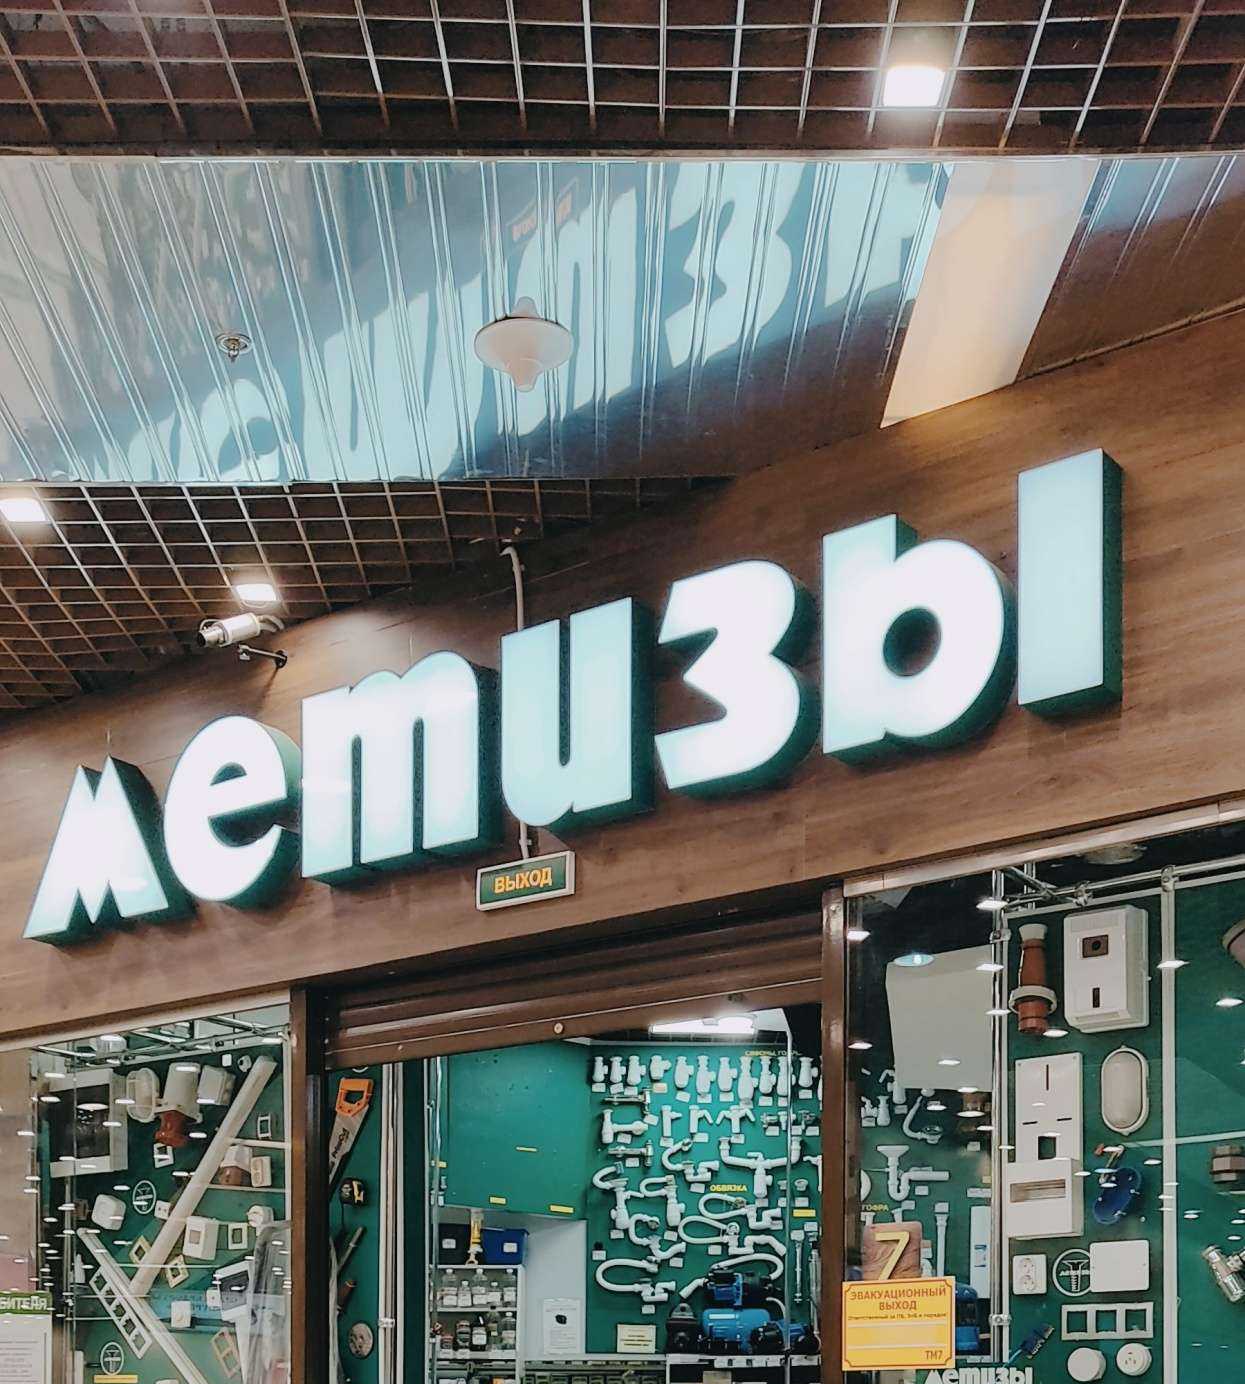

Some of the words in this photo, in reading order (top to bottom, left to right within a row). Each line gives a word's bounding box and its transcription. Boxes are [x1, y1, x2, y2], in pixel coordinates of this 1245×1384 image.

[494, 867, 552, 894] ВЫХОД
[874, 1231, 910, 1279] 7
[850, 1285, 946, 1301] ЭВАКУАЦИОННЫЙ
[879, 1300, 918, 1311] ВЫХОД
